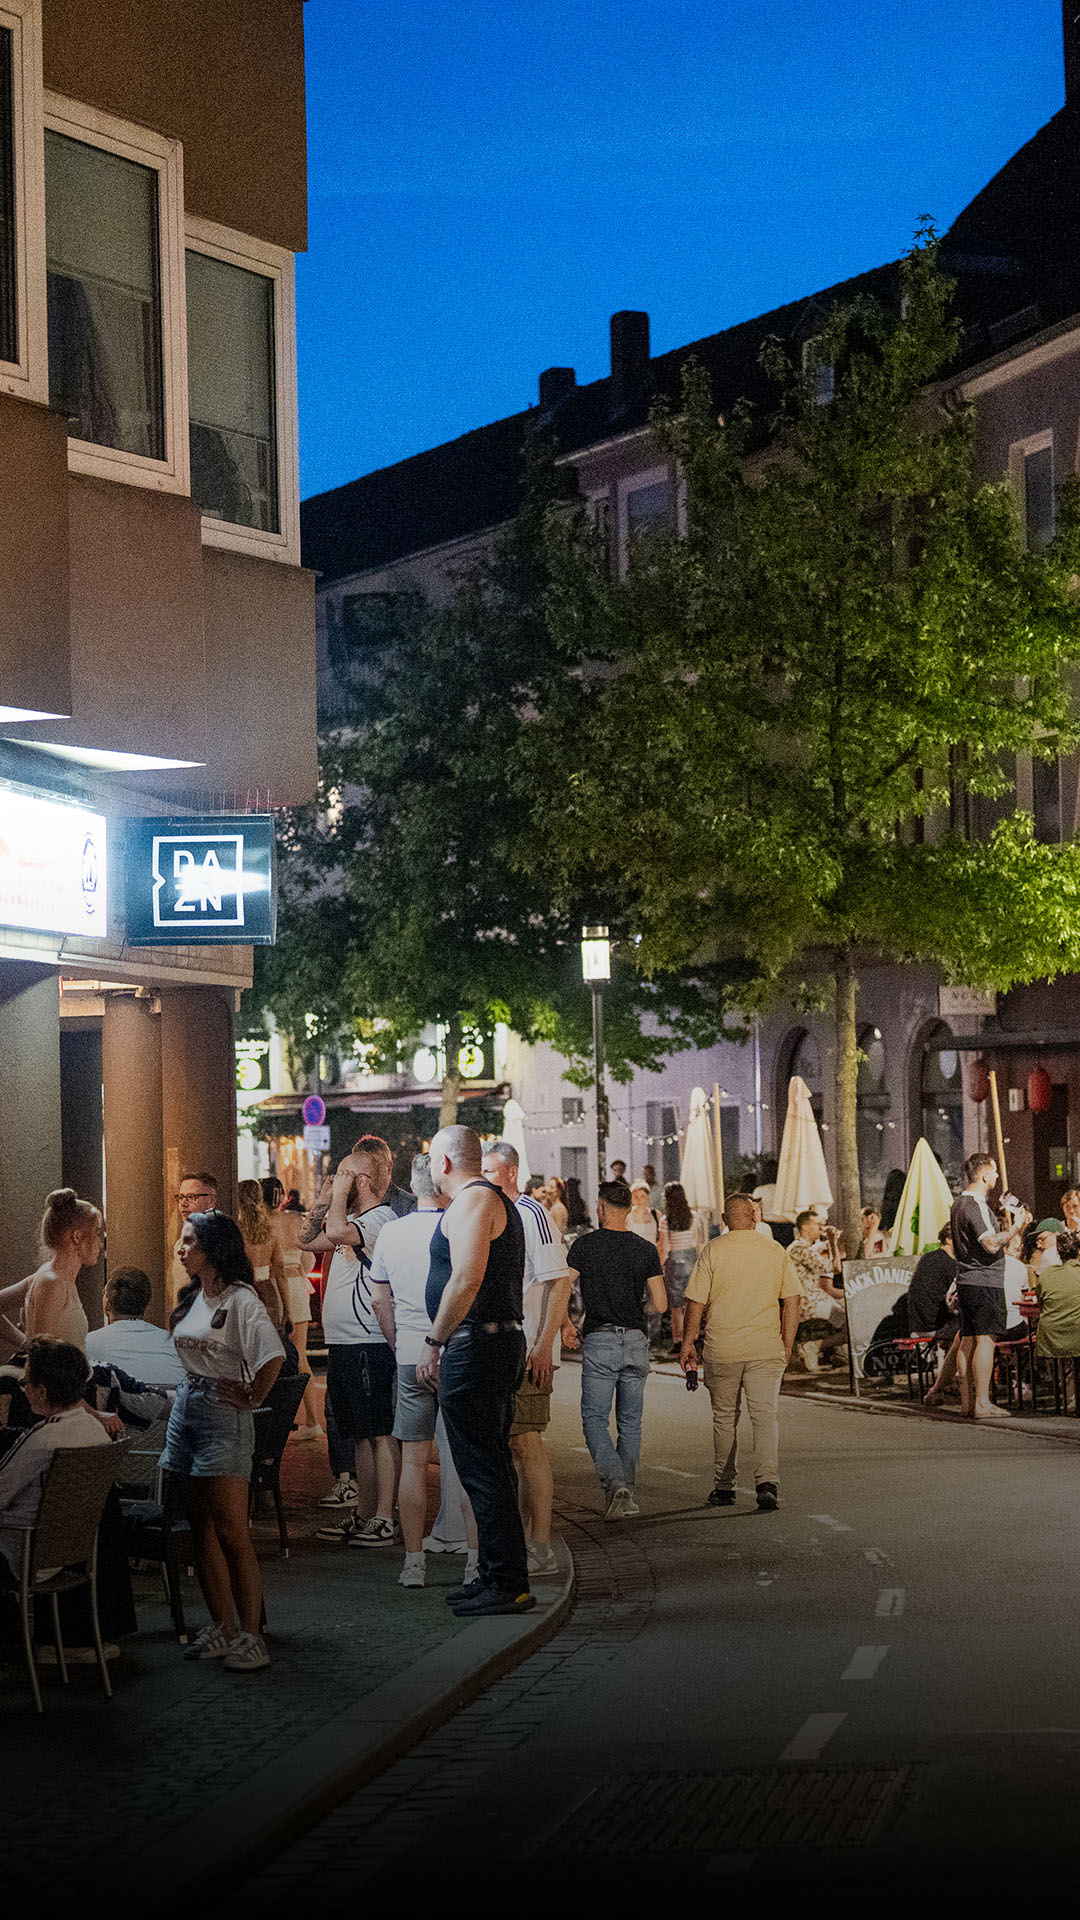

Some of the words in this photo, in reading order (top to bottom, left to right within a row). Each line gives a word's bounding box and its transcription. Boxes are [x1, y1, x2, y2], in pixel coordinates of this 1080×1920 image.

[173, 849, 223, 879] DA
[173, 884, 223, 912] ZN
[844, 1272, 875, 1300] JACK
